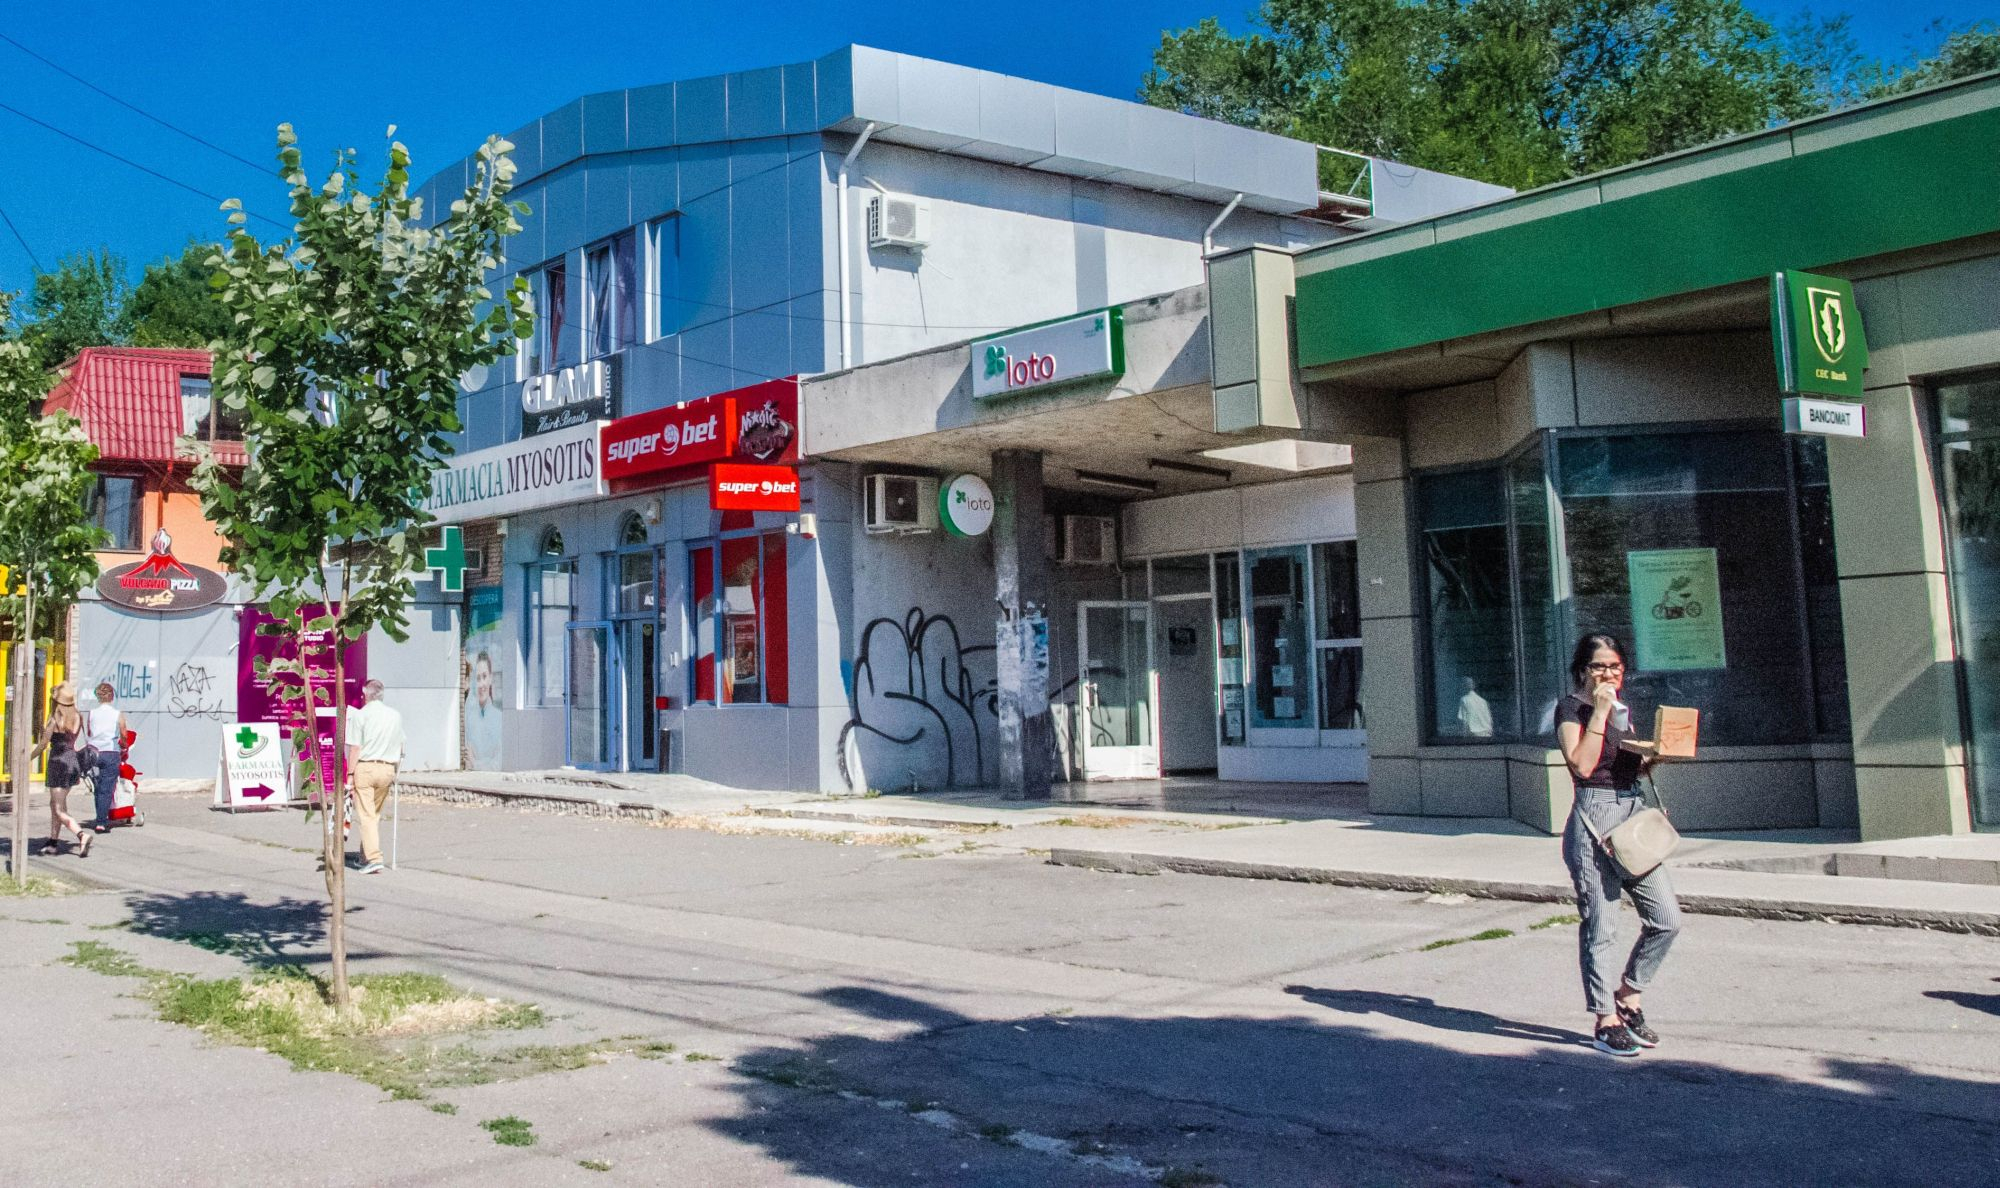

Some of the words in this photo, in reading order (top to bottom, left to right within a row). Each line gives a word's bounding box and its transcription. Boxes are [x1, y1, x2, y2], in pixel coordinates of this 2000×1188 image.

[1006, 352, 1056, 387] loto
[521, 360, 606, 413] GLAM
[1809, 408, 1851, 426] BANCOMAT
[427, 460, 504, 511] FARMACIA
[506, 437, 594, 495] MYOSOTIS
[967, 497, 991, 510] loto
[120, 578, 167, 589] VULCANO
[170, 578, 200, 591] PIZZA
[229, 761, 283, 770] FARMACIA
[231, 770, 285, 781] MYOSOTIS
